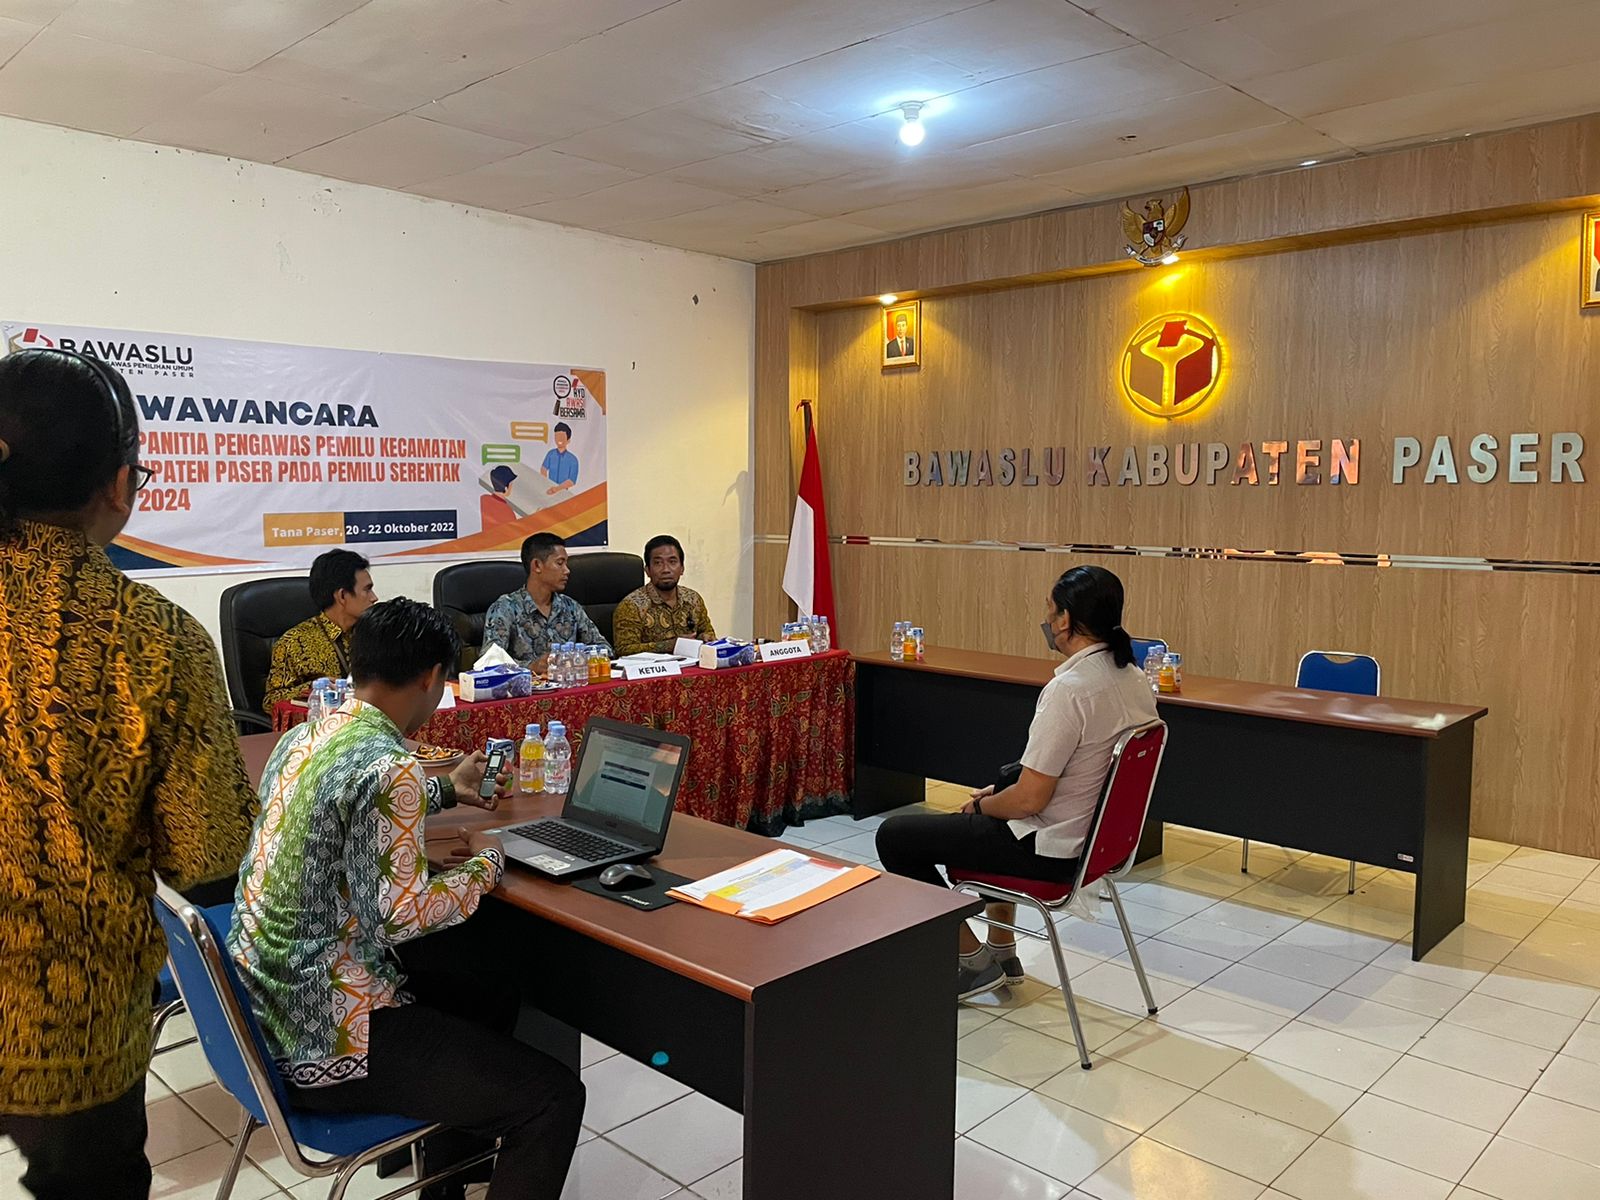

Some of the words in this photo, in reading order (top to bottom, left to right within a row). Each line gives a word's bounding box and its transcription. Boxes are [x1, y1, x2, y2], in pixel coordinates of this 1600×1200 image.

[133, 362, 172, 371] PEMILIHAN
[154, 370, 194, 378] PASER
[136, 394, 379, 428] WAWANCARA
[560, 407, 586, 418] BERSAMA
[215, 432, 311, 457] PENGAWAS
[316, 435, 374, 457] PEMILU
[380, 437, 466, 459] KECAMATAN
[903, 446, 1066, 487] BAWASLU
[1086, 438, 1361, 487] KABUPATEN
[1392, 432, 1585, 485] PASER
[216, 460, 273, 483] PASER
[278, 461, 323, 483] PADA
[328, 461, 385, 482] PEMILU
[390, 462, 460, 482] SERENTAK
[138, 487, 191, 512] 2024
[272, 527, 303, 538] Tana
[306, 526, 343, 537] Paser,
[346, 525, 359, 535] 20
[368, 524, 381, 534] 22
[384, 523, 429, 534] Oktober
[430, 522, 454, 532] 2022
[770, 646, 802, 657] ANGGOTA
[638, 665, 668, 676] KETUA
